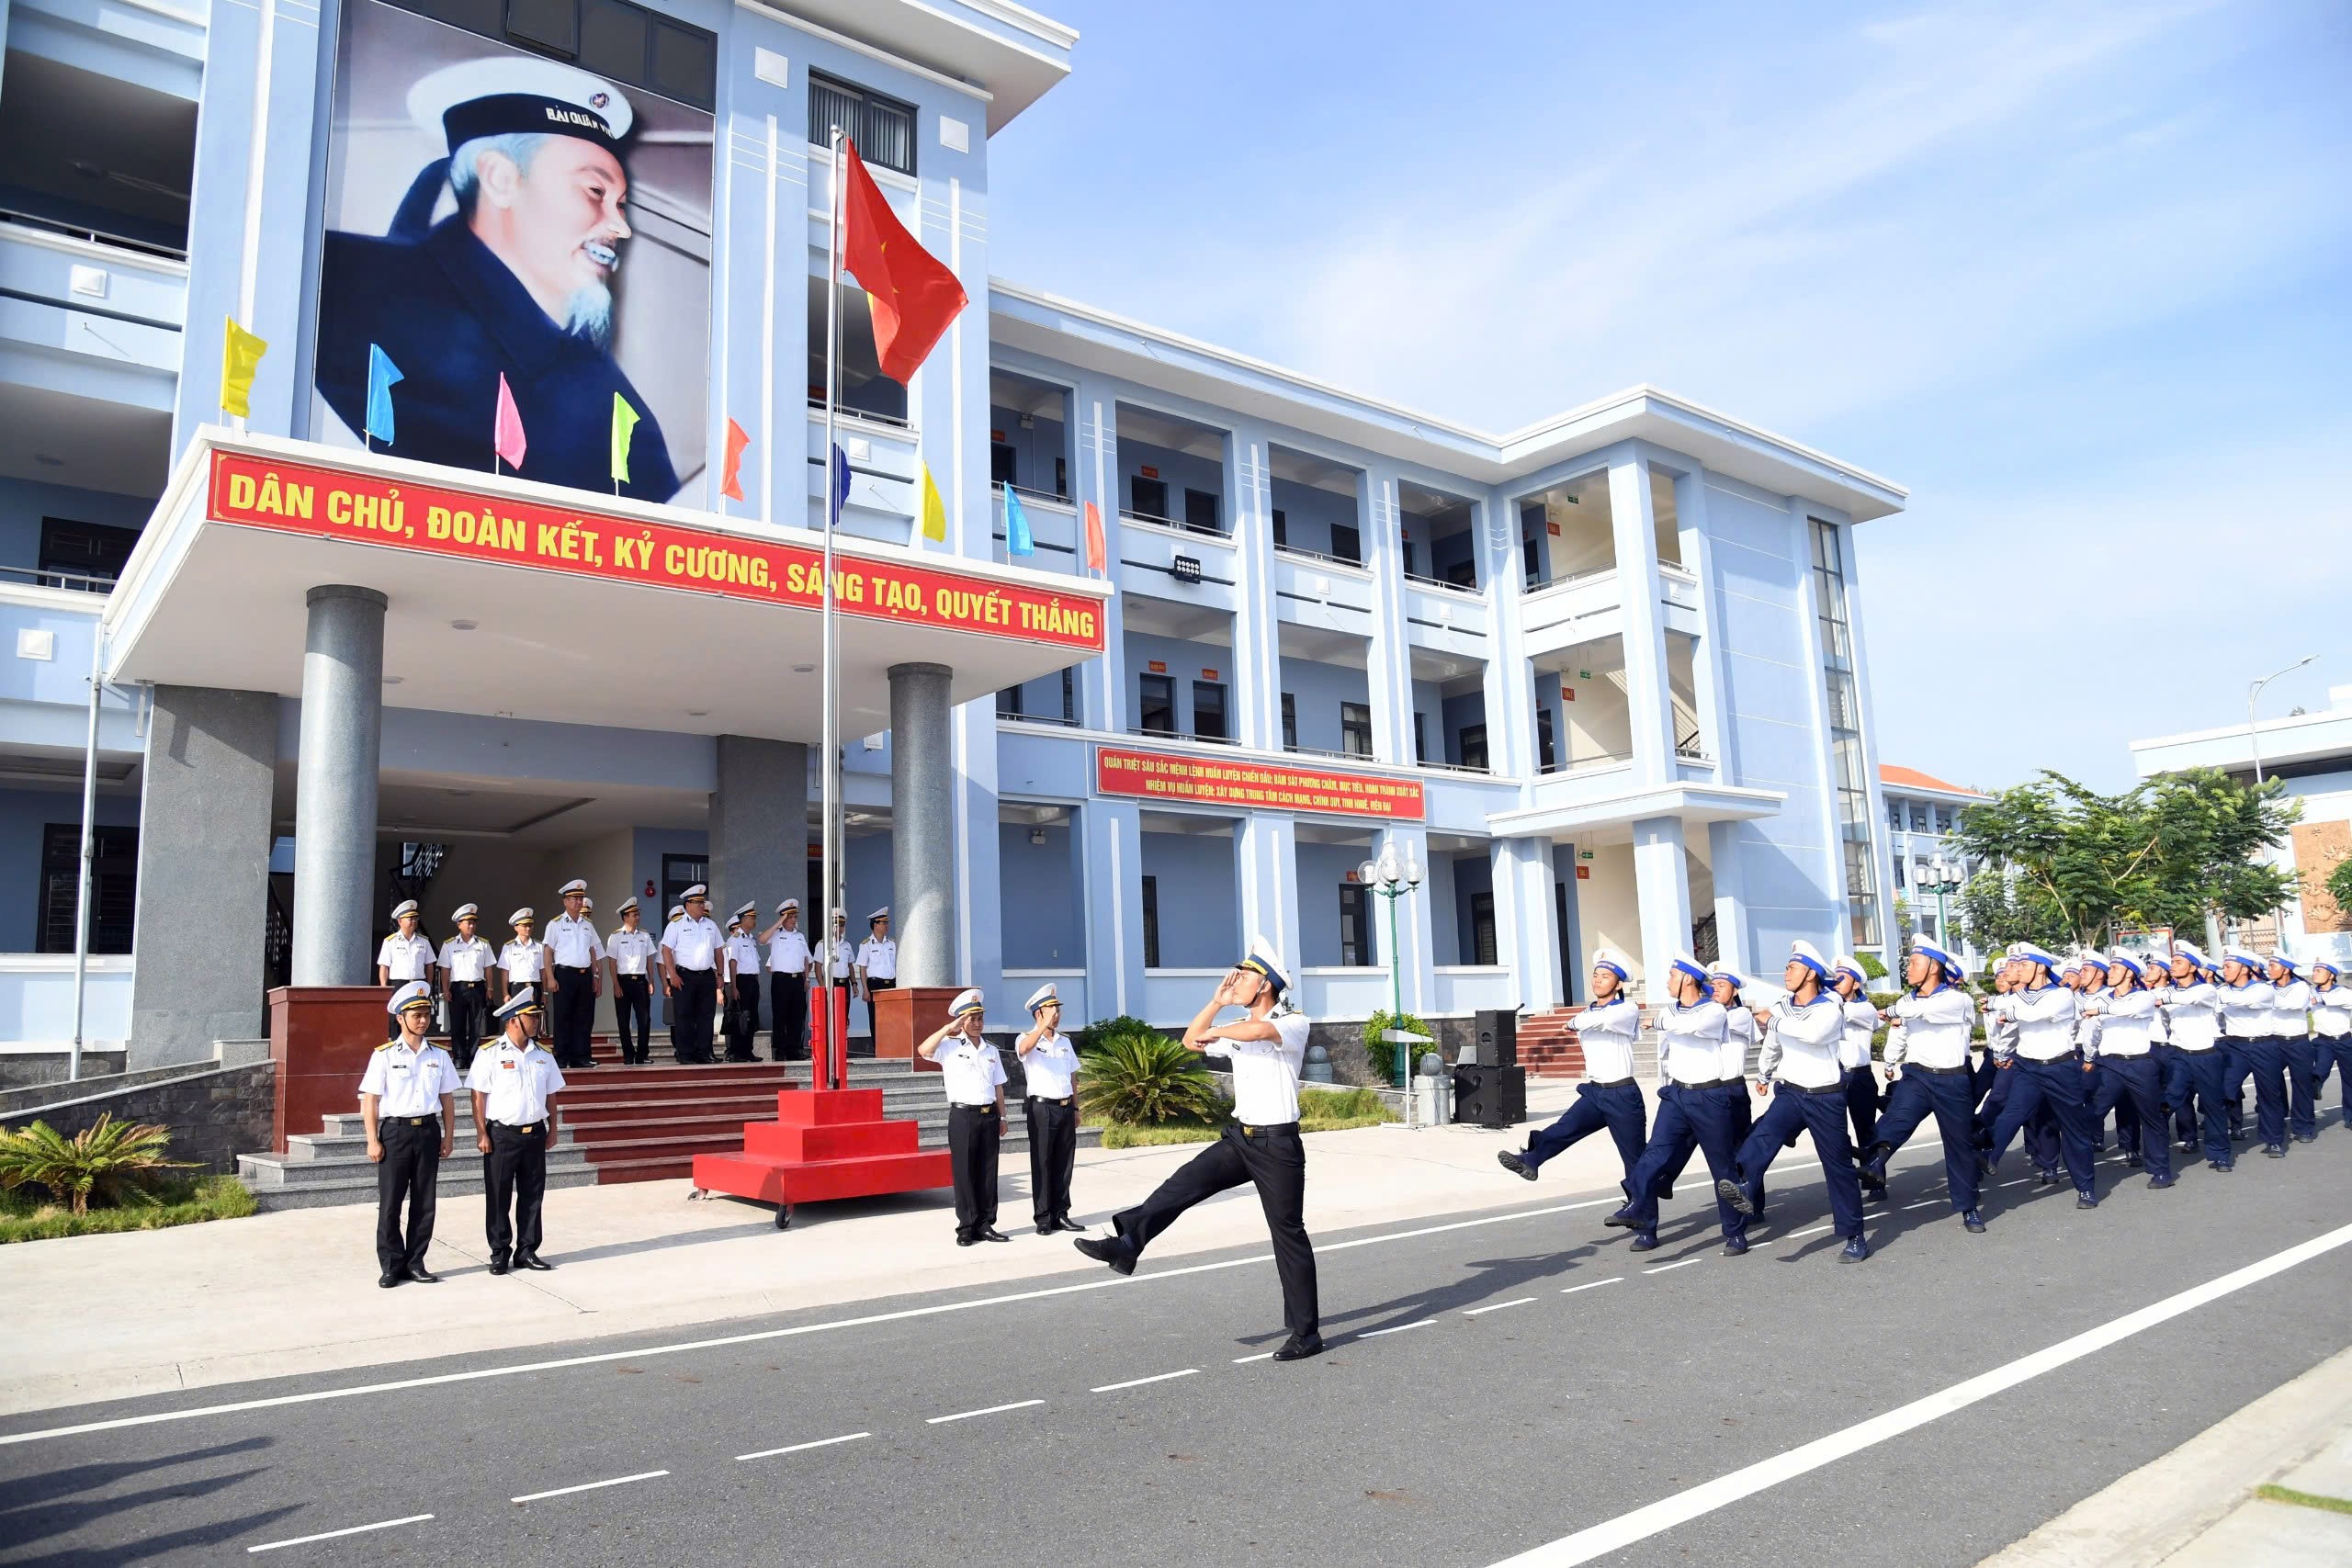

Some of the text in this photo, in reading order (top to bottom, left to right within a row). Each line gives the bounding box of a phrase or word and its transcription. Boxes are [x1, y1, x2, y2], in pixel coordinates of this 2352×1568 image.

[229, 472, 1095, 638] DÂN CHỦ, ĐOÀN KẾT, KỶ CƯƠNG, SÁNG TẠO, QUYẾT THẮNG
[1104, 755, 1122, 769] QUÁN
[1123, 758, 1140, 773] TRIỆT
[1142, 759, 1154, 772] SÂU
[1156, 759, 1169, 774] SẮC
[1170, 763, 1187, 776] MỆNH
[1189, 764, 1204, 778] LỆNH
[1205, 764, 1222, 779] HUẤN
[1222, 768, 1240, 782] LUYỆN
[1241, 768, 1259, 782] CHIẾN
[1408, 784, 1419, 798] SẮC
[1146, 779, 1166, 793] NHIỆM
[1167, 782, 1176, 795] VỤ
[1177, 780, 1193, 794] HUẤN
[1216, 785, 1227, 796] XÂY
